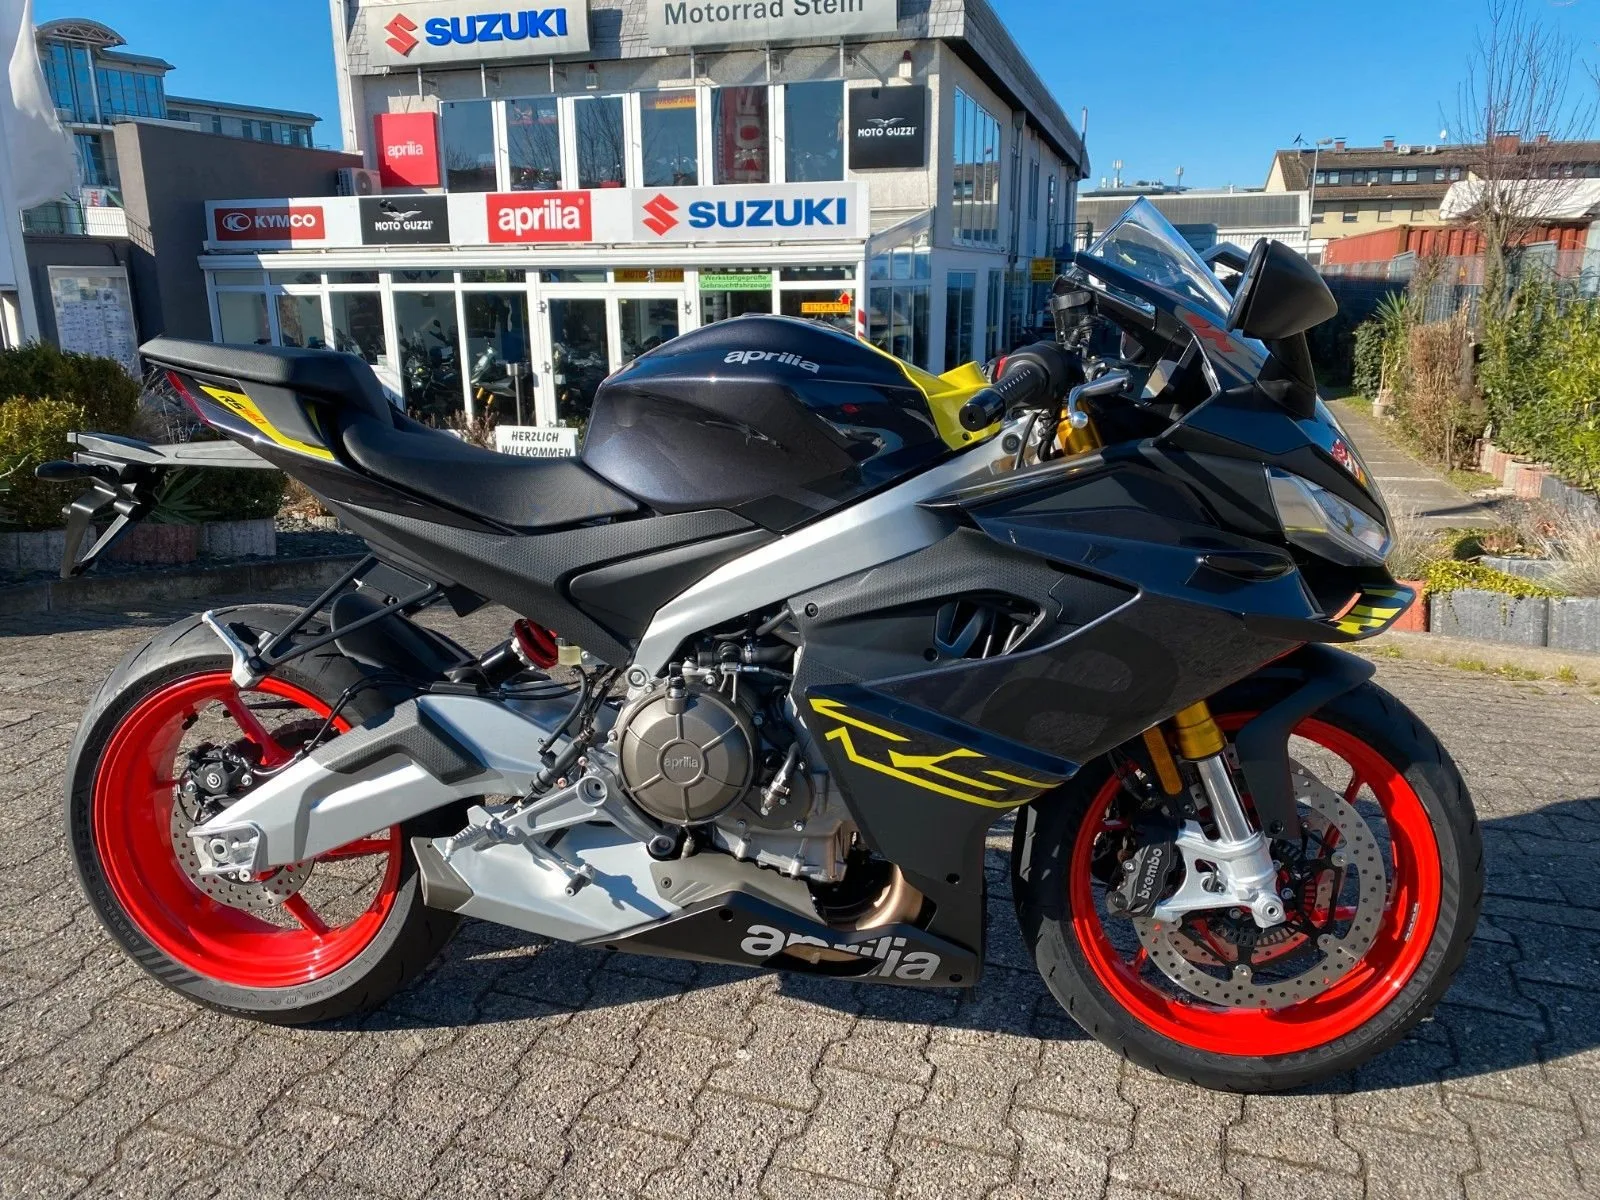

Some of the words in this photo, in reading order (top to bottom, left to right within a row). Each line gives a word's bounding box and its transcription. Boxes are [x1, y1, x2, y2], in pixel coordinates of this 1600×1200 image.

[664, 0, 783, 25] Motorrad
[425, 8, 567, 46] SUZUKI
[857, 128, 884, 137] MOTO
[886, 126, 914, 136] GUZZI
[387, 141, 424, 159] aprilia
[498, 199, 580, 237] aprilia
[688, 197, 847, 228] SUZUKI
[255, 214, 316, 228] KYMCO
[375, 220, 401, 231] MOTO
[403, 219, 433, 230] GUZZI
[803, 303, 849, 311] EINGANG
[723, 350, 820, 374] aprilia
[511, 431, 559, 443] HERZLICH
[502, 445, 572, 457] WILLKOMMEN
[663, 756, 699, 770] aprilia
[1137, 848, 1163, 900] brembo
